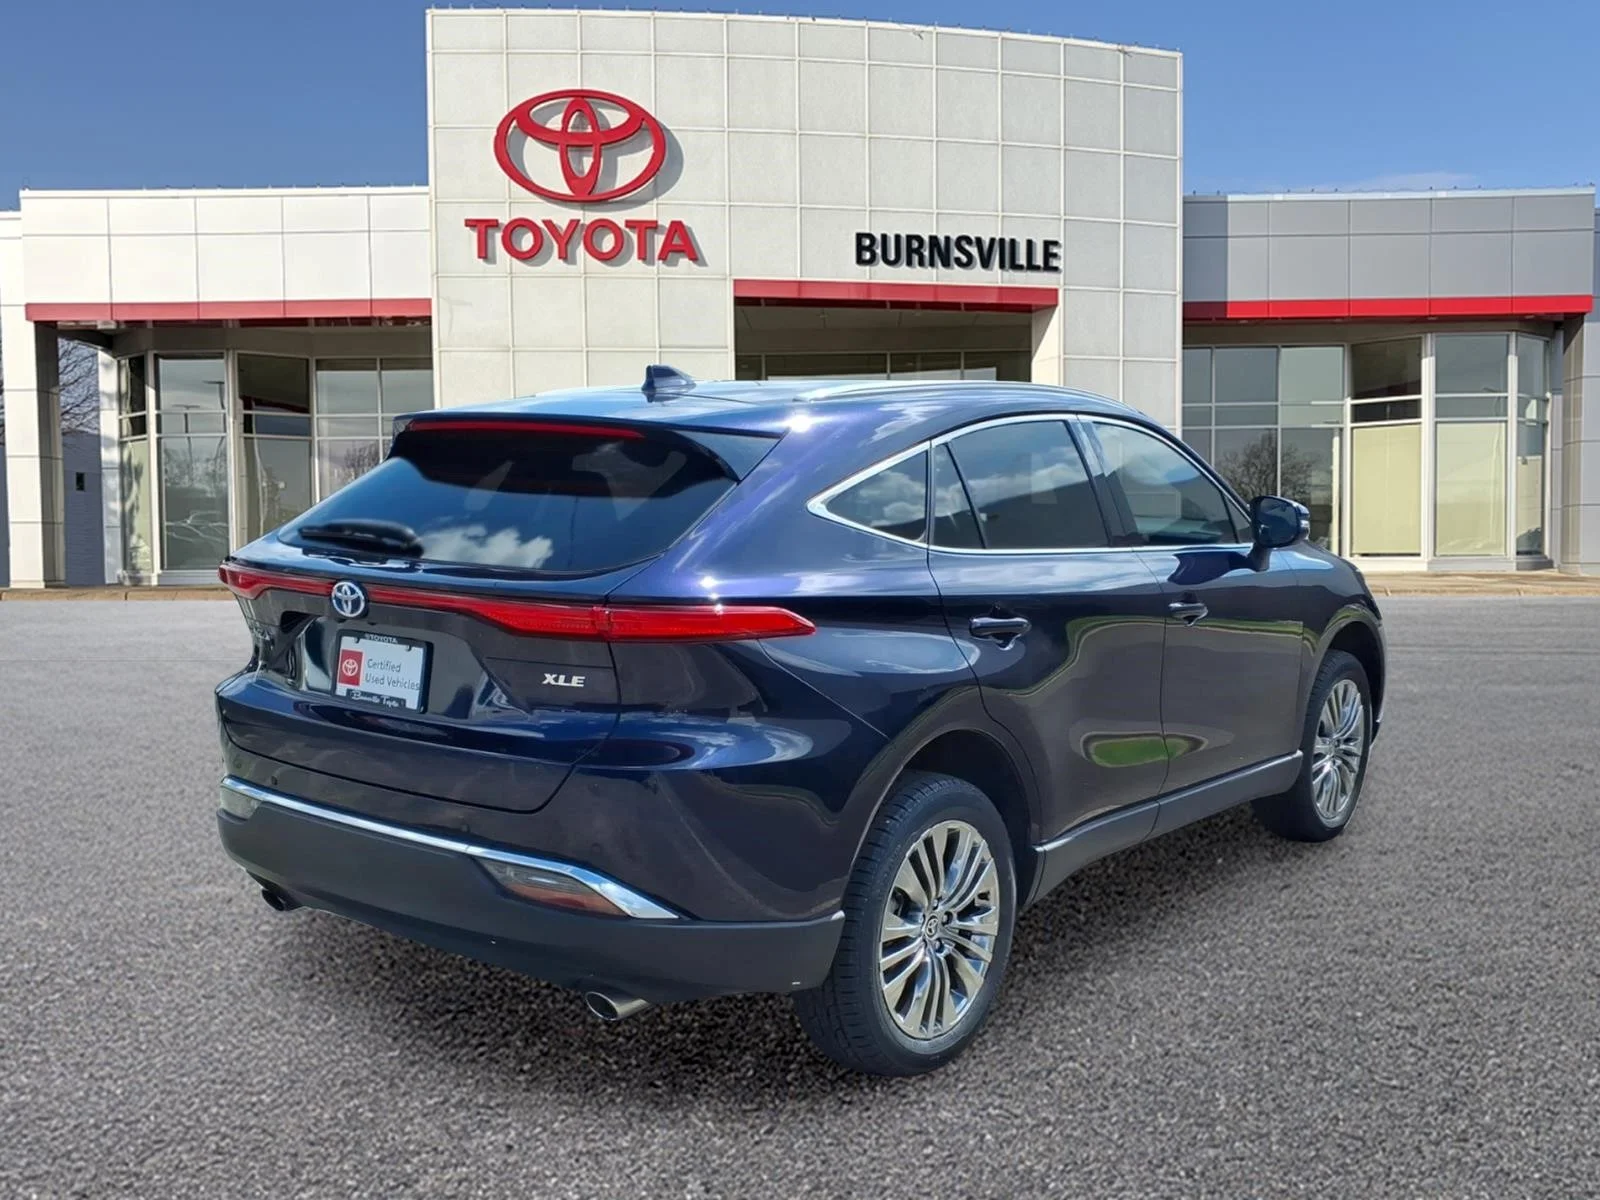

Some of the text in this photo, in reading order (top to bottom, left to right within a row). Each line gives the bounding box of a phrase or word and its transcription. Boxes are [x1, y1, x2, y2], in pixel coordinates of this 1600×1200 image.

[464, 217, 699, 262] TOYOTA
[855, 232, 1062, 272] BURNSVILLE
[367, 658, 402, 673] Certified
[365, 673, 420, 691] Used Vehicles
[541, 673, 586, 688] XLE
